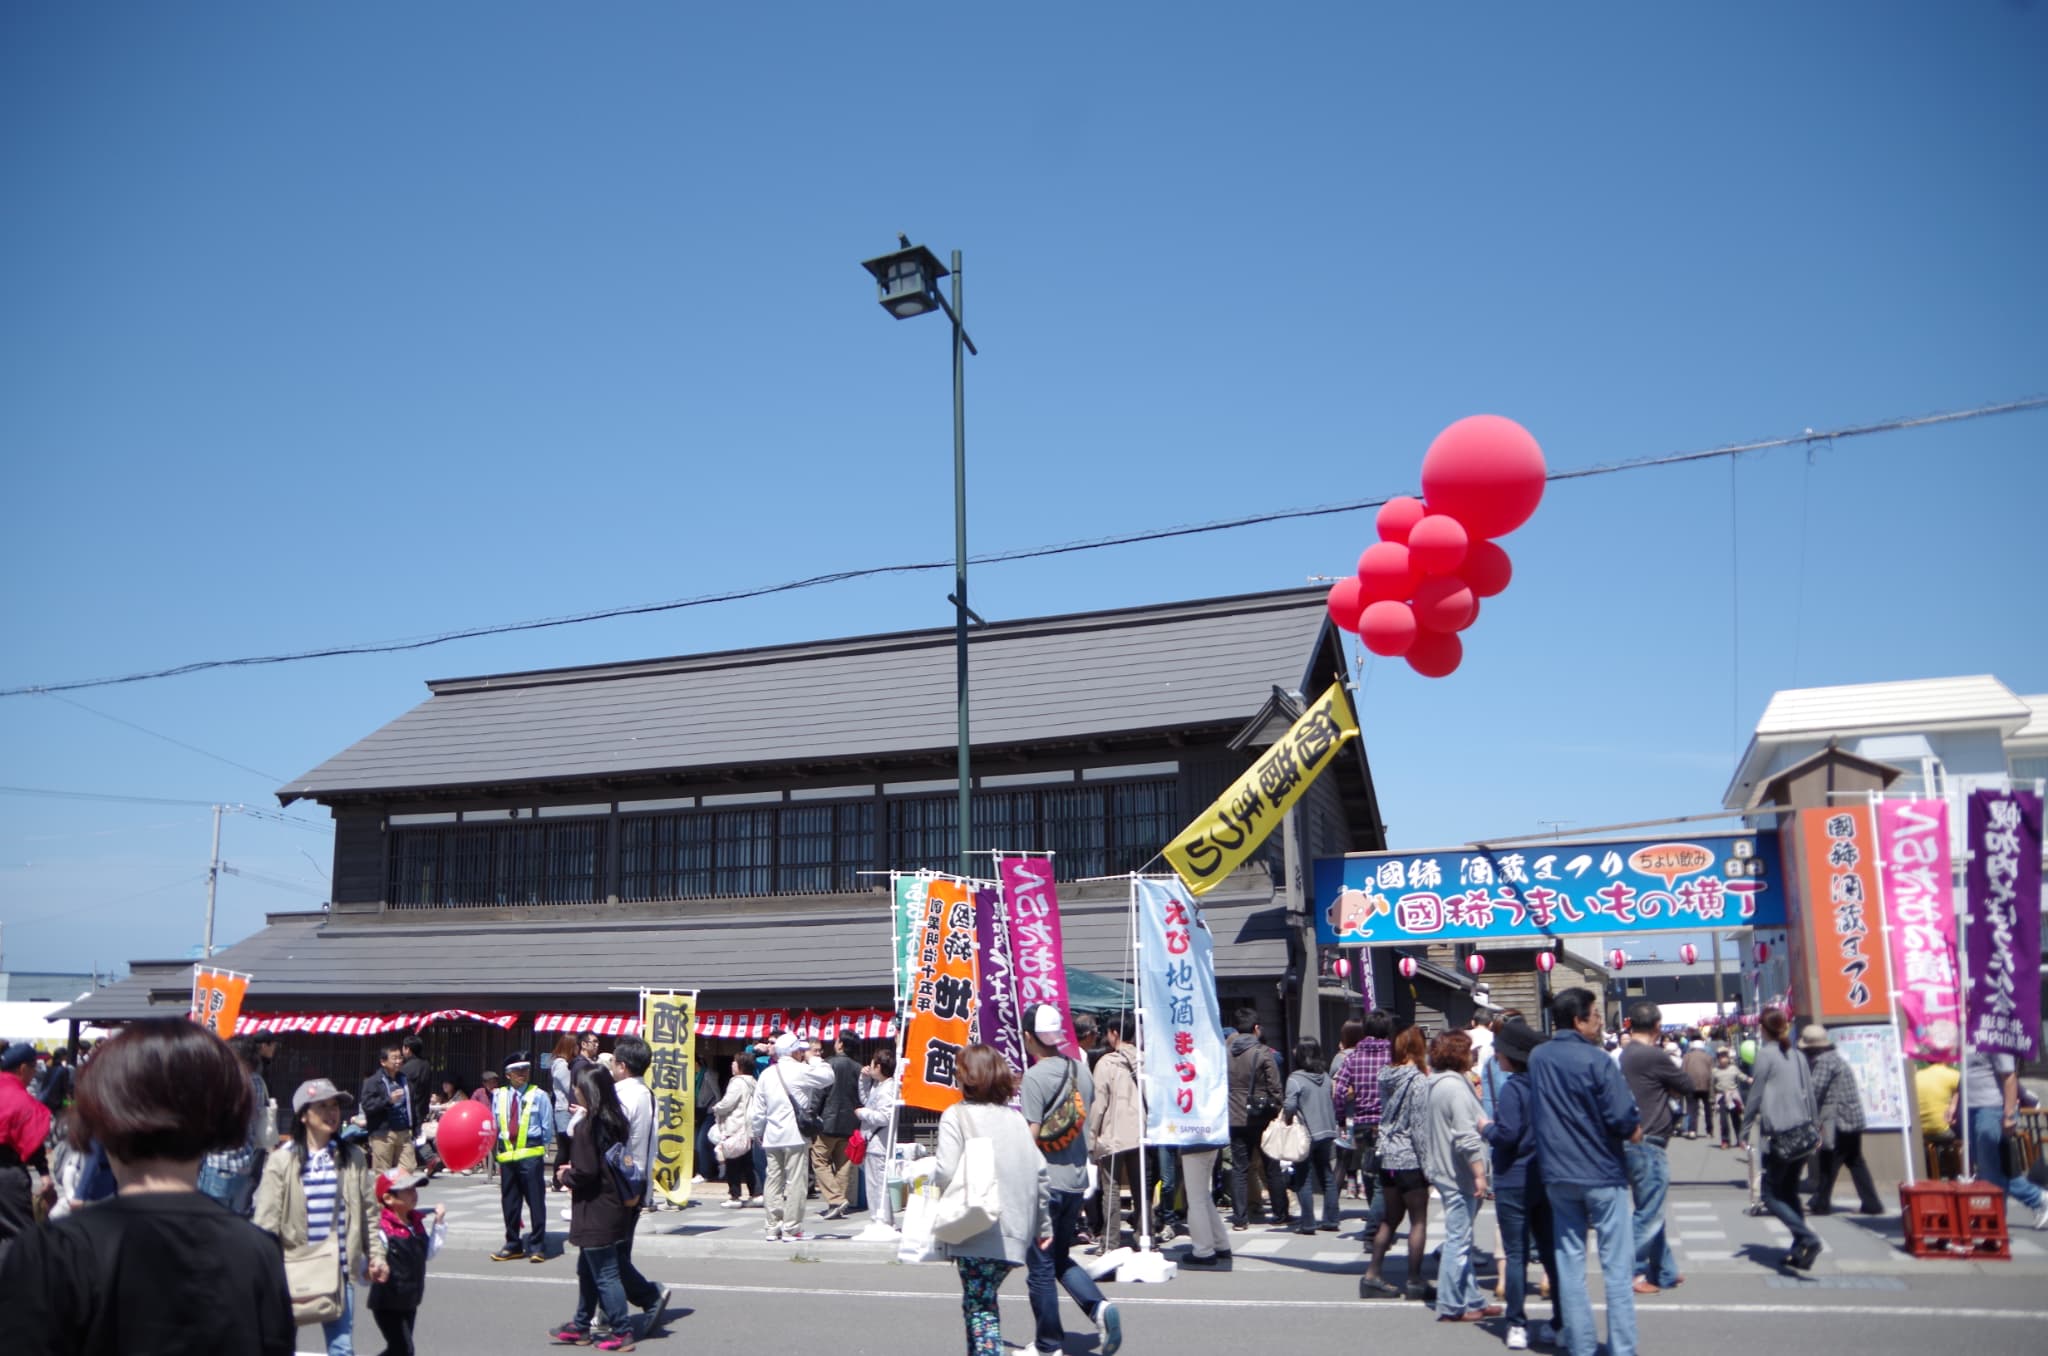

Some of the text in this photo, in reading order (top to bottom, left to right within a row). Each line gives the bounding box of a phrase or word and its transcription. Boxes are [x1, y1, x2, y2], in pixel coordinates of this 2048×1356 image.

[1185, 700, 1341, 878] 酒蔵まつり
[1376, 850, 1624, 889] 國稀 酒蔵まつり
[1640, 850, 1706, 869] ちょい飲み
[1395, 879, 1768, 933] 國稀うまいもの横丁
[1164, 899, 1197, 1114] えび地酒まつり
